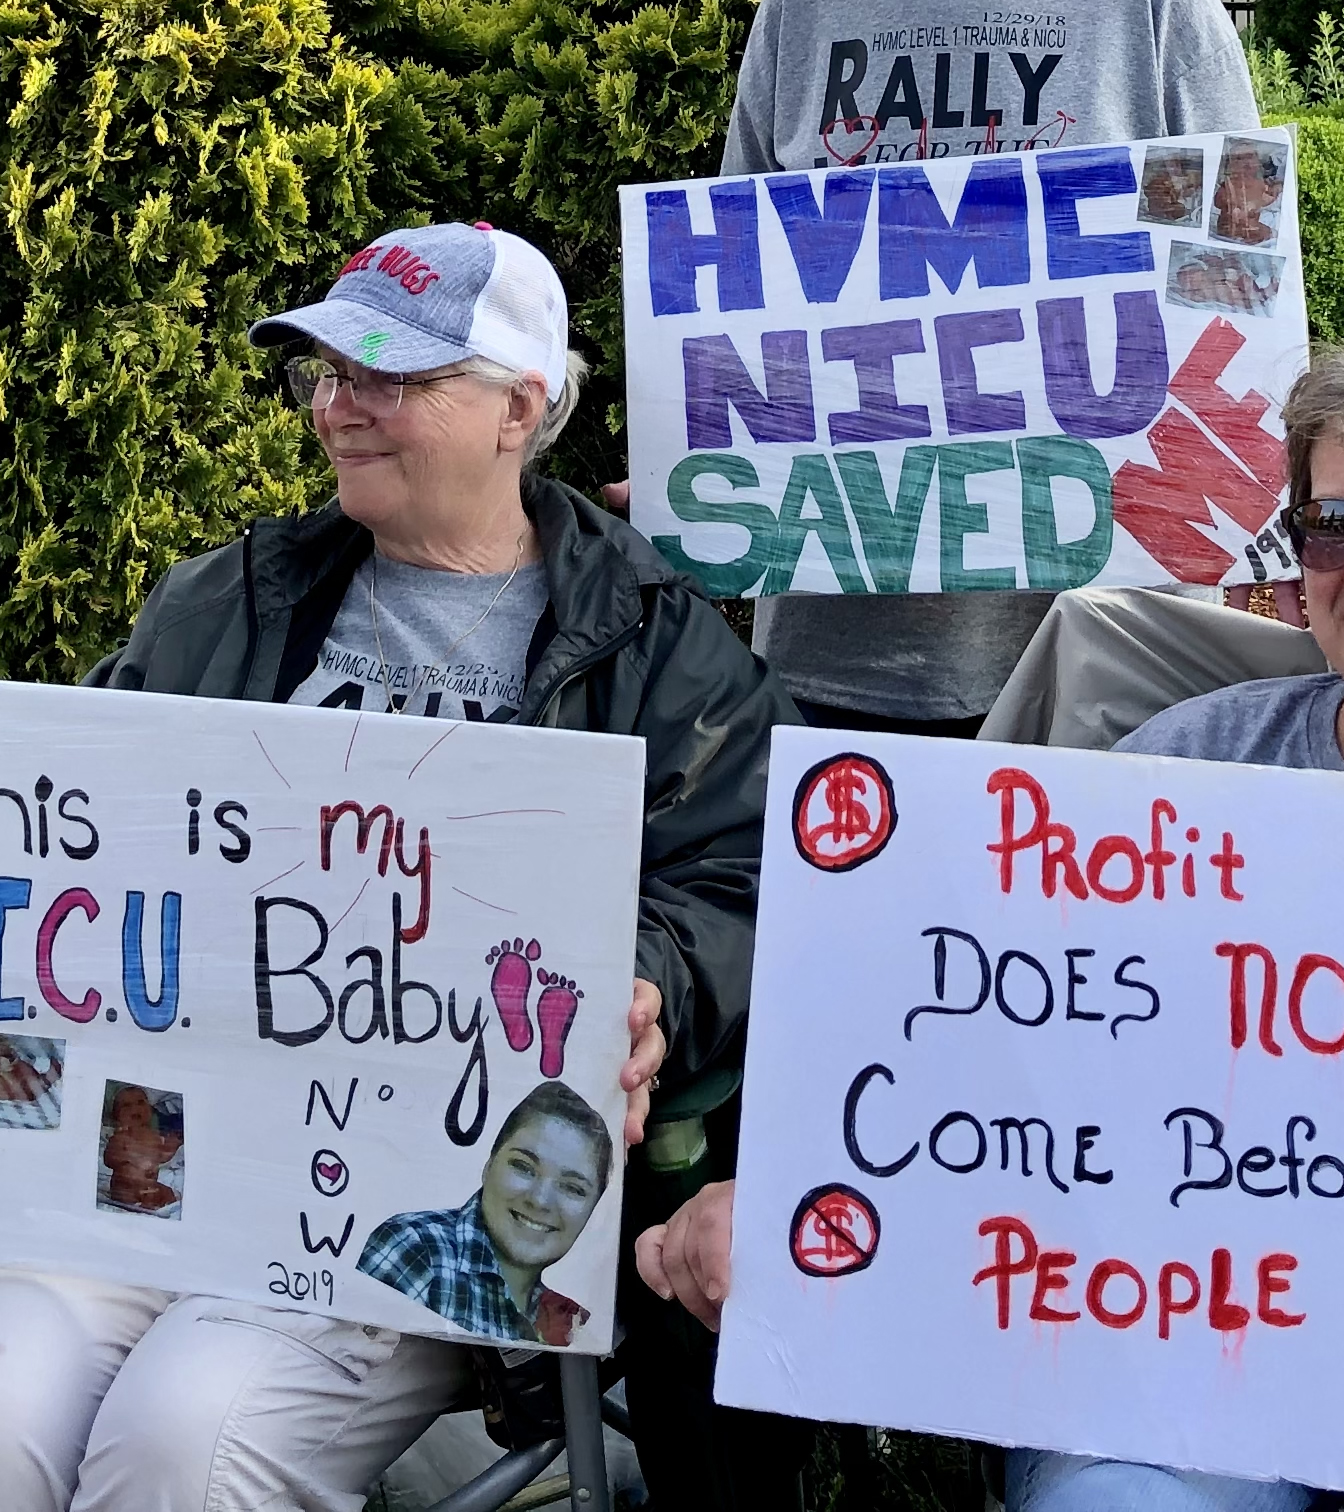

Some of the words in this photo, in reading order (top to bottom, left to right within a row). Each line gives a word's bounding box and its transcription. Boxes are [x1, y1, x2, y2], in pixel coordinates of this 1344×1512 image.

[872, 30, 907, 52] HVMC
[909, 26, 949, 49] LEVEL
[952, 26, 958, 47] 1
[962, 25, 1018, 48] TRAUMA
[1020, 29, 1030, 47] &
[1033, 29, 1067, 49] NICU
[982, 11, 1067, 27] 12/29/18
[818, 38, 1064, 135] RALLY
[376, 244, 441, 296] HUGS
[644, 147, 1156, 317] HVMC
[682, 290, 1169, 450] NICU
[651, 435, 1114, 599] SAVED
[322, 649, 369, 681] HVMC
[366, 660, 408, 688] LEVEL
[419, 665, 477, 696] TRAUMA
[478, 676, 489, 697] &
[186, 787, 253, 863] is
[320, 799, 433, 944] my
[255, 892, 490, 1147] Baby
[903, 926, 1161, 1041] DOES
[267, 1261, 335, 1306] 2019
